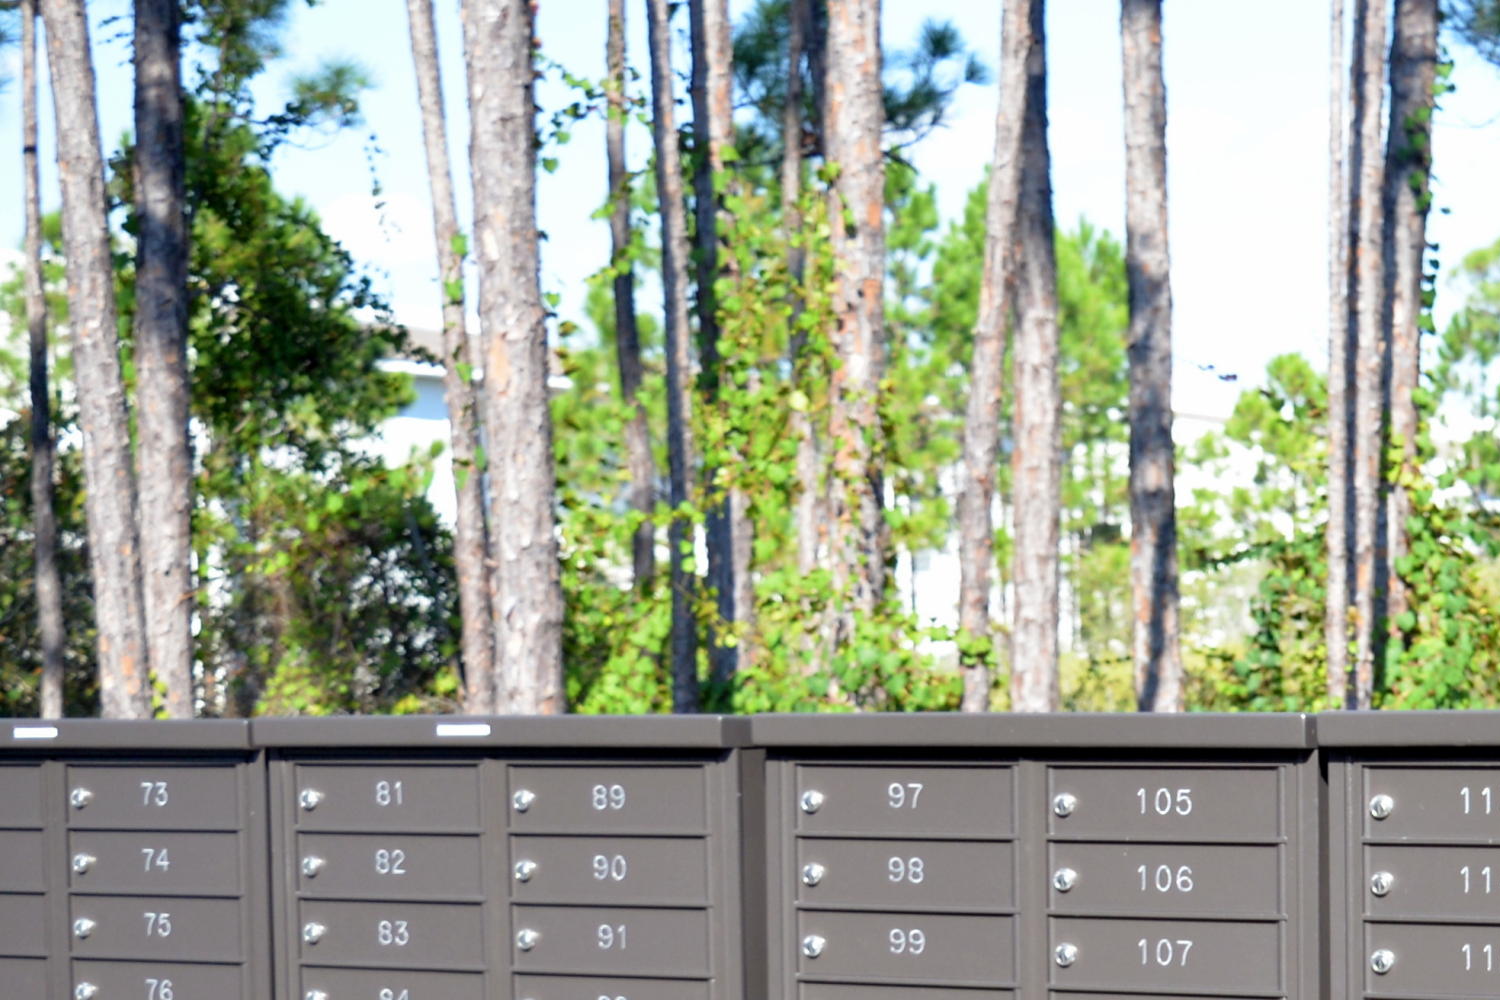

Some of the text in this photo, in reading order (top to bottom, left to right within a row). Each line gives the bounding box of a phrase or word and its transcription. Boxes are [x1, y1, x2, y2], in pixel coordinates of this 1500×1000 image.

[140, 781, 169, 807] 73
[375, 780, 403, 807] 81
[591, 783, 626, 811] 89
[887, 782, 924, 809] 97
[1136, 787, 1193, 816] 105
[141, 847, 171, 872] 74
[375, 848, 407, 875] 82
[592, 854, 627, 882] 90
[887, 855, 925, 885] 98
[1137, 864, 1194, 893] 106
[143, 911, 172, 938] 75
[377, 919, 410, 947] 83
[597, 923, 626, 950] 91
[888, 927, 926, 955] 99
[1137, 938, 1194, 967] 107
